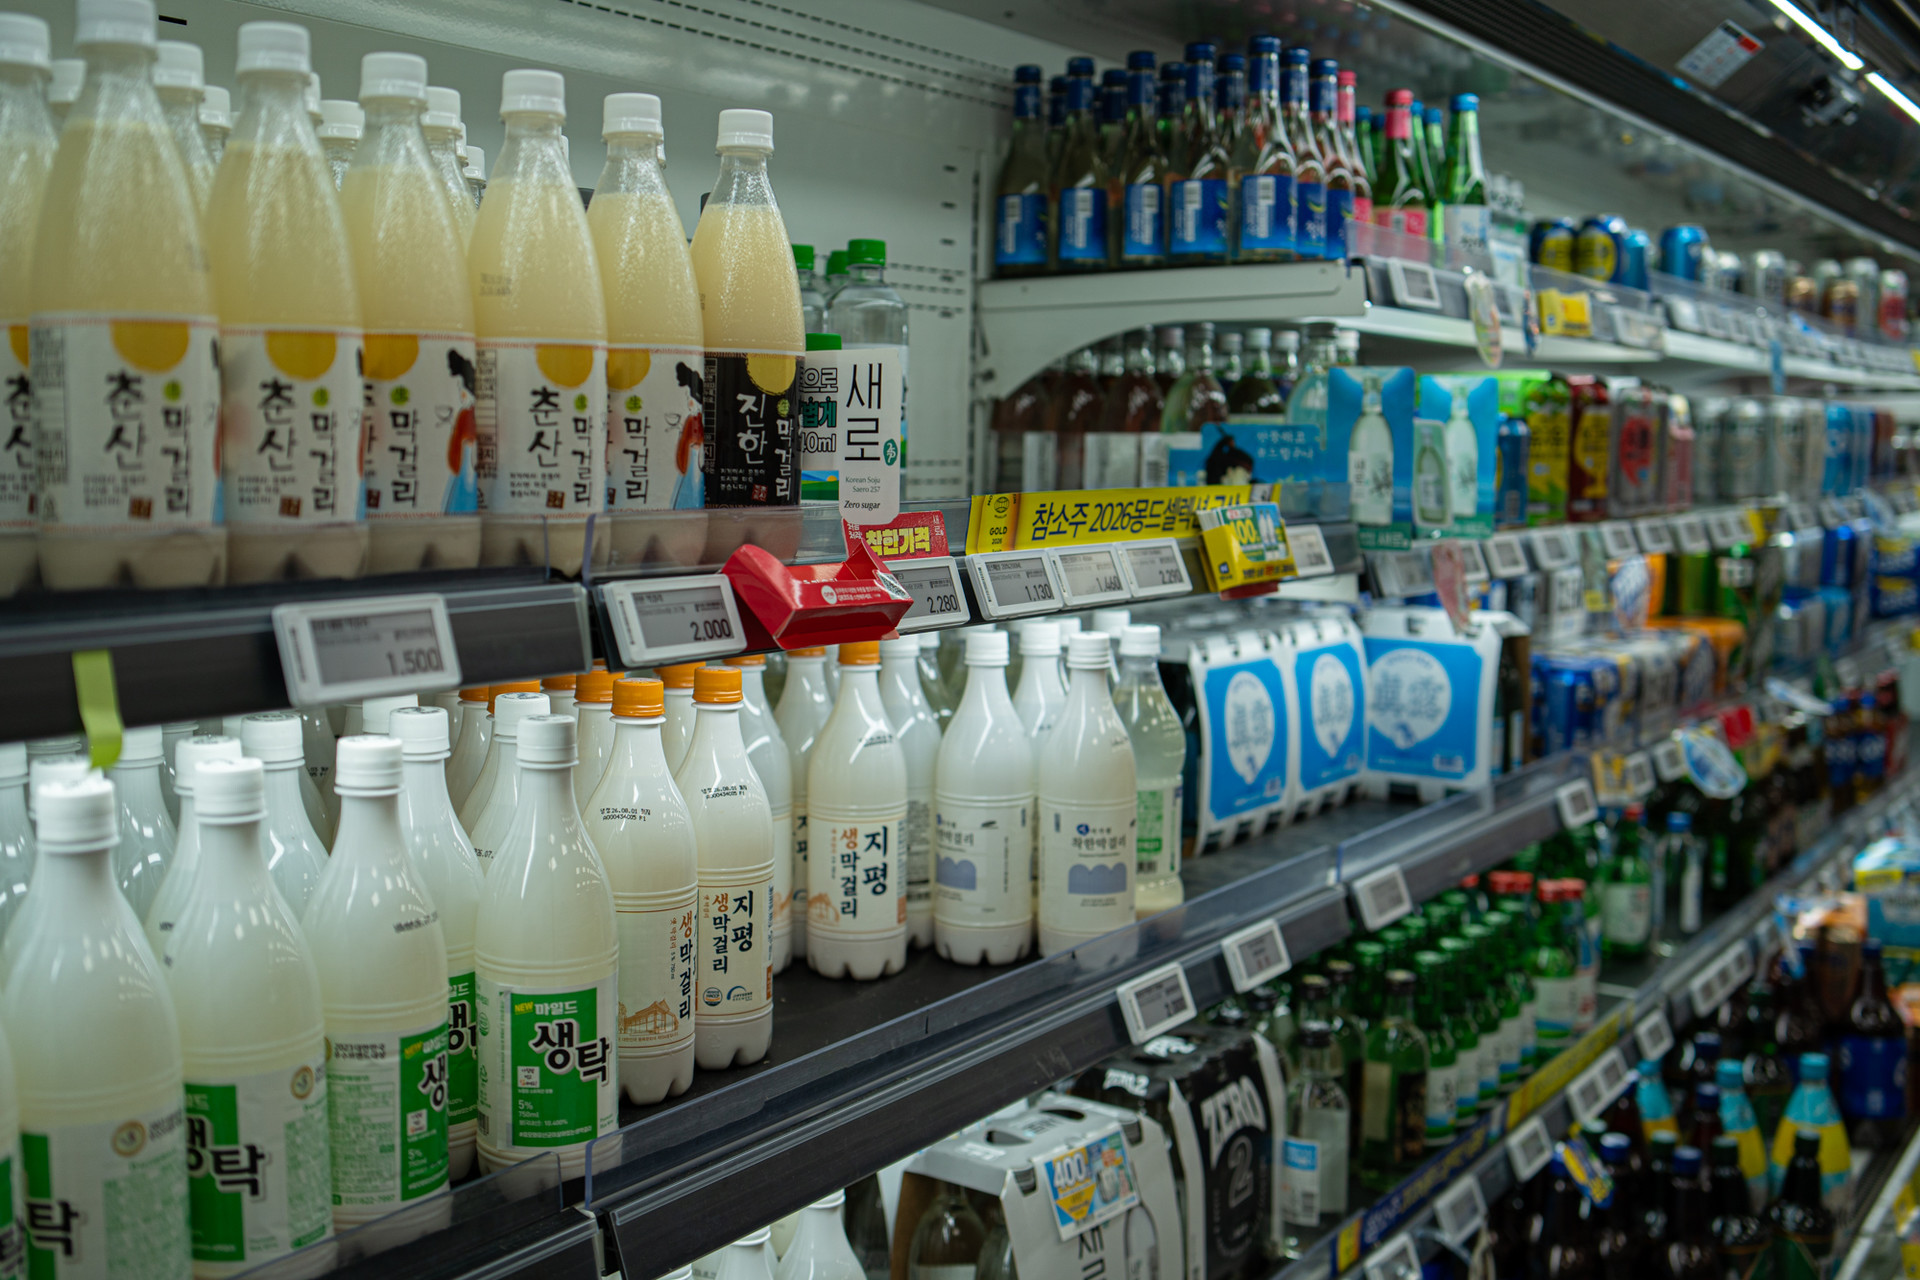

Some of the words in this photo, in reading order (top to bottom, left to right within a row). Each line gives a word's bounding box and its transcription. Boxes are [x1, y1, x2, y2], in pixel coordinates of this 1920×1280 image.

[528, 386, 562, 468] 춘산
[737, 393, 768, 465] 진한
[844, 363, 882, 461] 새로
[161, 405, 191, 517] 막걸리
[308, 410, 336, 516] 막걸리
[387, 410, 421, 508] 막걸리
[571, 416, 594, 508] 막걸리
[623, 416, 651, 504] 막걸리
[774, 418, 794, 501] 막걸리
[845, 476, 867, 484] Korean
[867, 476, 881, 485] Soju
[844, 500, 861, 509] Zero
[861, 502, 881, 511] sugar
[866, 526, 931, 556] 착한가격
[989, 526, 1008, 536] GOLD
[1031, 502, 1090, 541] 참소주
[927, 594, 958, 614] 2,280
[840, 827, 861, 920] 생막걸리
[862, 826, 889, 896] 지평
[712, 893, 732, 976] 생막걸리
[732, 890, 754, 953] 지평
[679, 910, 694, 1021] 생막걸리
[514, 1001, 535, 1014] NEW
[534, 1000, 577, 1016] 마일드
[531, 1021, 609, 1083] 생탁
[518, 1099, 533, 1110] 5%
[1199, 1075, 1266, 1171] ZERO
[1053, 1152, 1086, 1190] 400
[1228, 1135, 1253, 1208] 2
[26, 1200, 80, 1256] 탁
